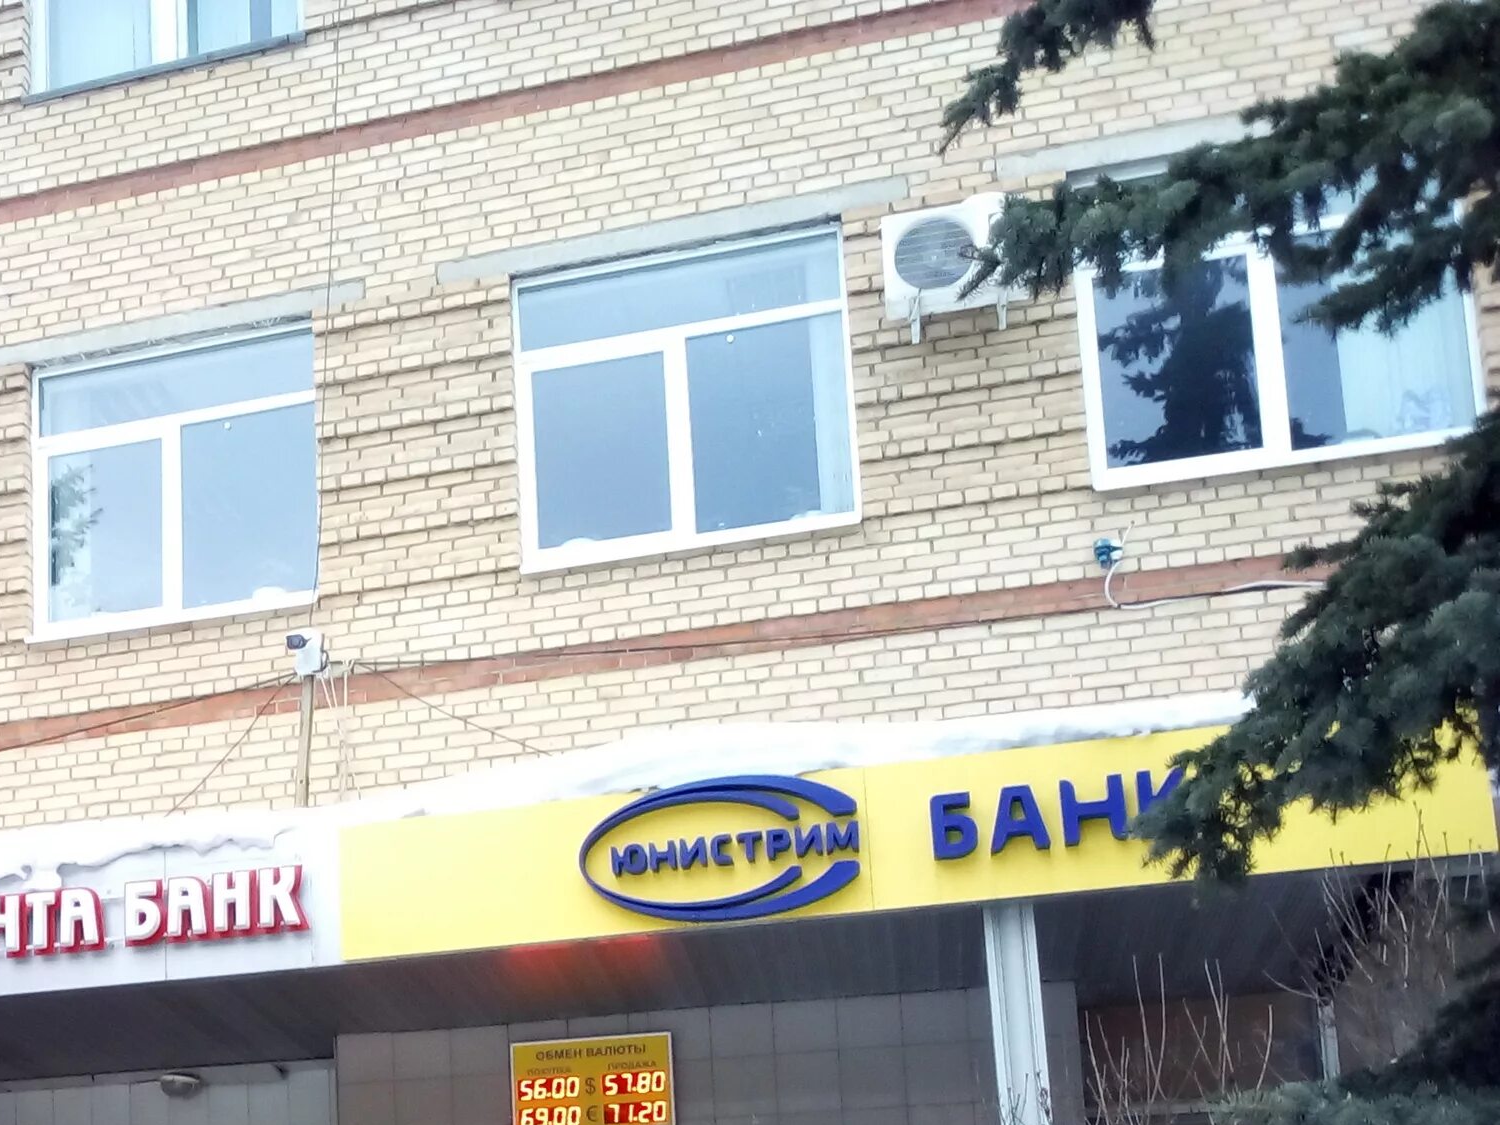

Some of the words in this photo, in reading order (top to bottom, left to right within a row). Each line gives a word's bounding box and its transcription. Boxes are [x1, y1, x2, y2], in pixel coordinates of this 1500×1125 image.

[610, 820, 861, 877] ЮНИСТРИМ
[124, 864, 311, 947] БАНК
[535, 1046, 582, 1061] ОБМЕН
[586, 1043, 646, 1058] ВАЛЮТЫ
[607, 1060, 657, 1071] ПРОДАЖА
[520, 1076, 580, 1101] 56.00
[585, 1077, 596, 1095] $
[604, 1071, 666, 1096] 57.80
[586, 1105, 598, 1122] €
[608, 1100, 667, 1123] 71.20
